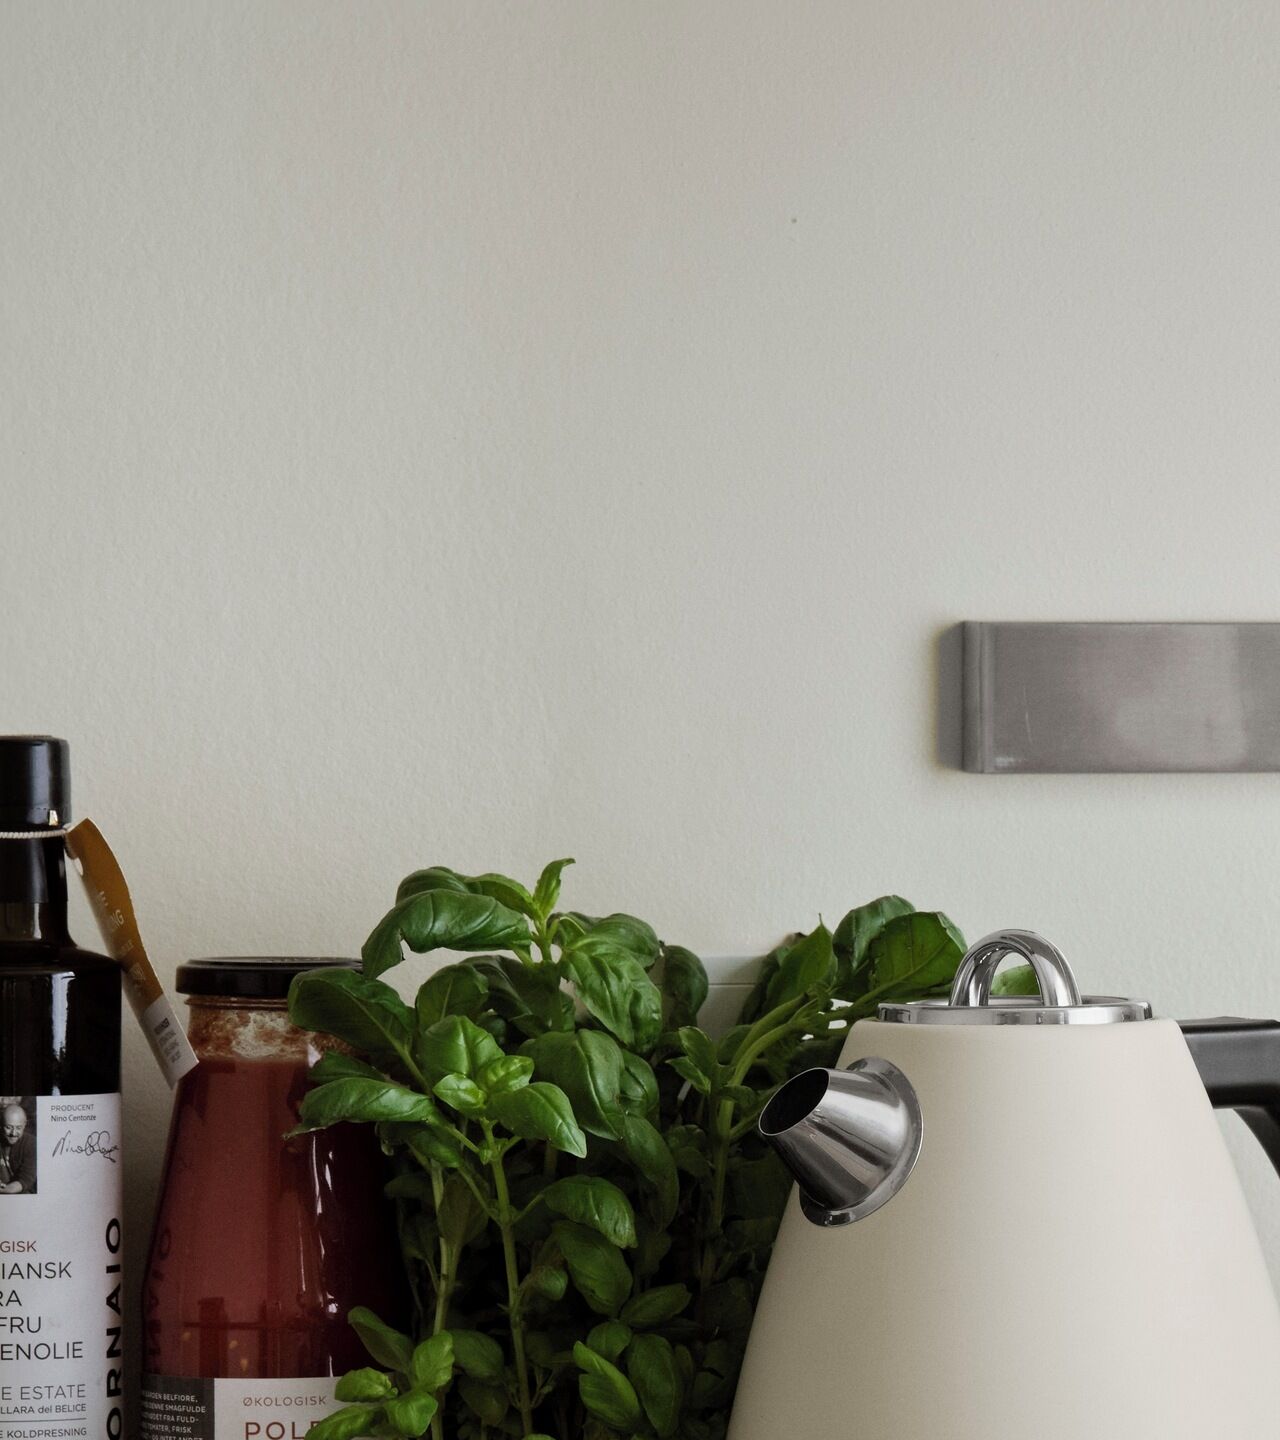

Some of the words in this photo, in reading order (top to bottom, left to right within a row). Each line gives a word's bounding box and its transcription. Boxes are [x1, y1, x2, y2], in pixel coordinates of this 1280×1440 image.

[0, 1240, 37, 1253] GISK
[1, 1261, 72, 1279] IANSK
[0, 1341, 83, 1360] ENOLIE
[20, 1383, 86, 1400] ESTATE
[243, 1395, 327, 1407] ØKOLOGISK
[37, 1404, 53, 1414] del
[55, 1403, 87, 1413] BELICE
[165, 1404, 206, 1413] SMAGFULDE
[7, 1427, 87, 1438] KOLDPRESNING
